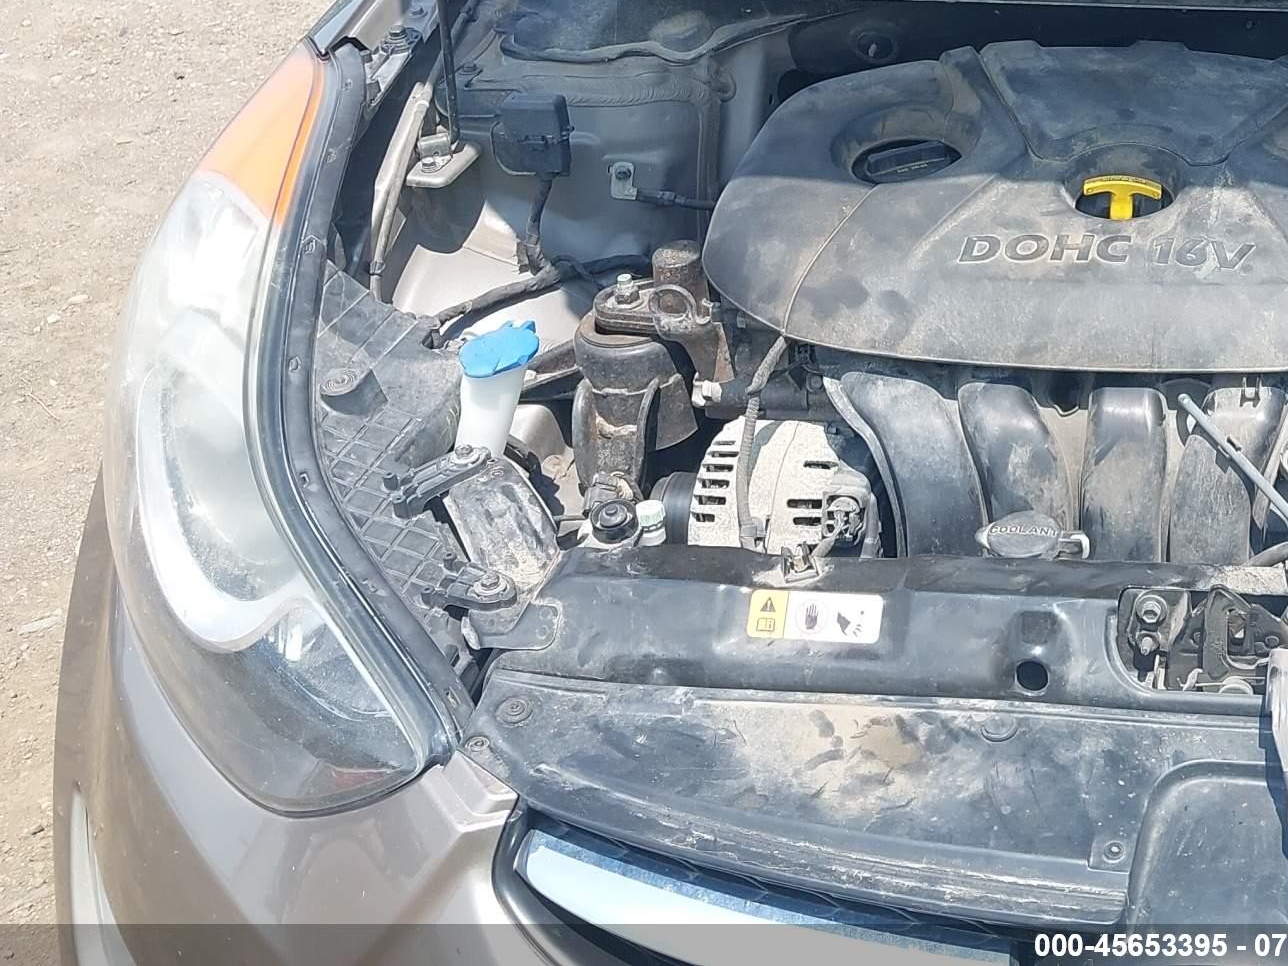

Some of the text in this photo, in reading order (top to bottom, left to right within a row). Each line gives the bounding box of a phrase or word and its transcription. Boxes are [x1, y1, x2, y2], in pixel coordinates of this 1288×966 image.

[958, 234, 1255, 270] DOHC 16V
[989, 524, 1058, 538] COOLANT
